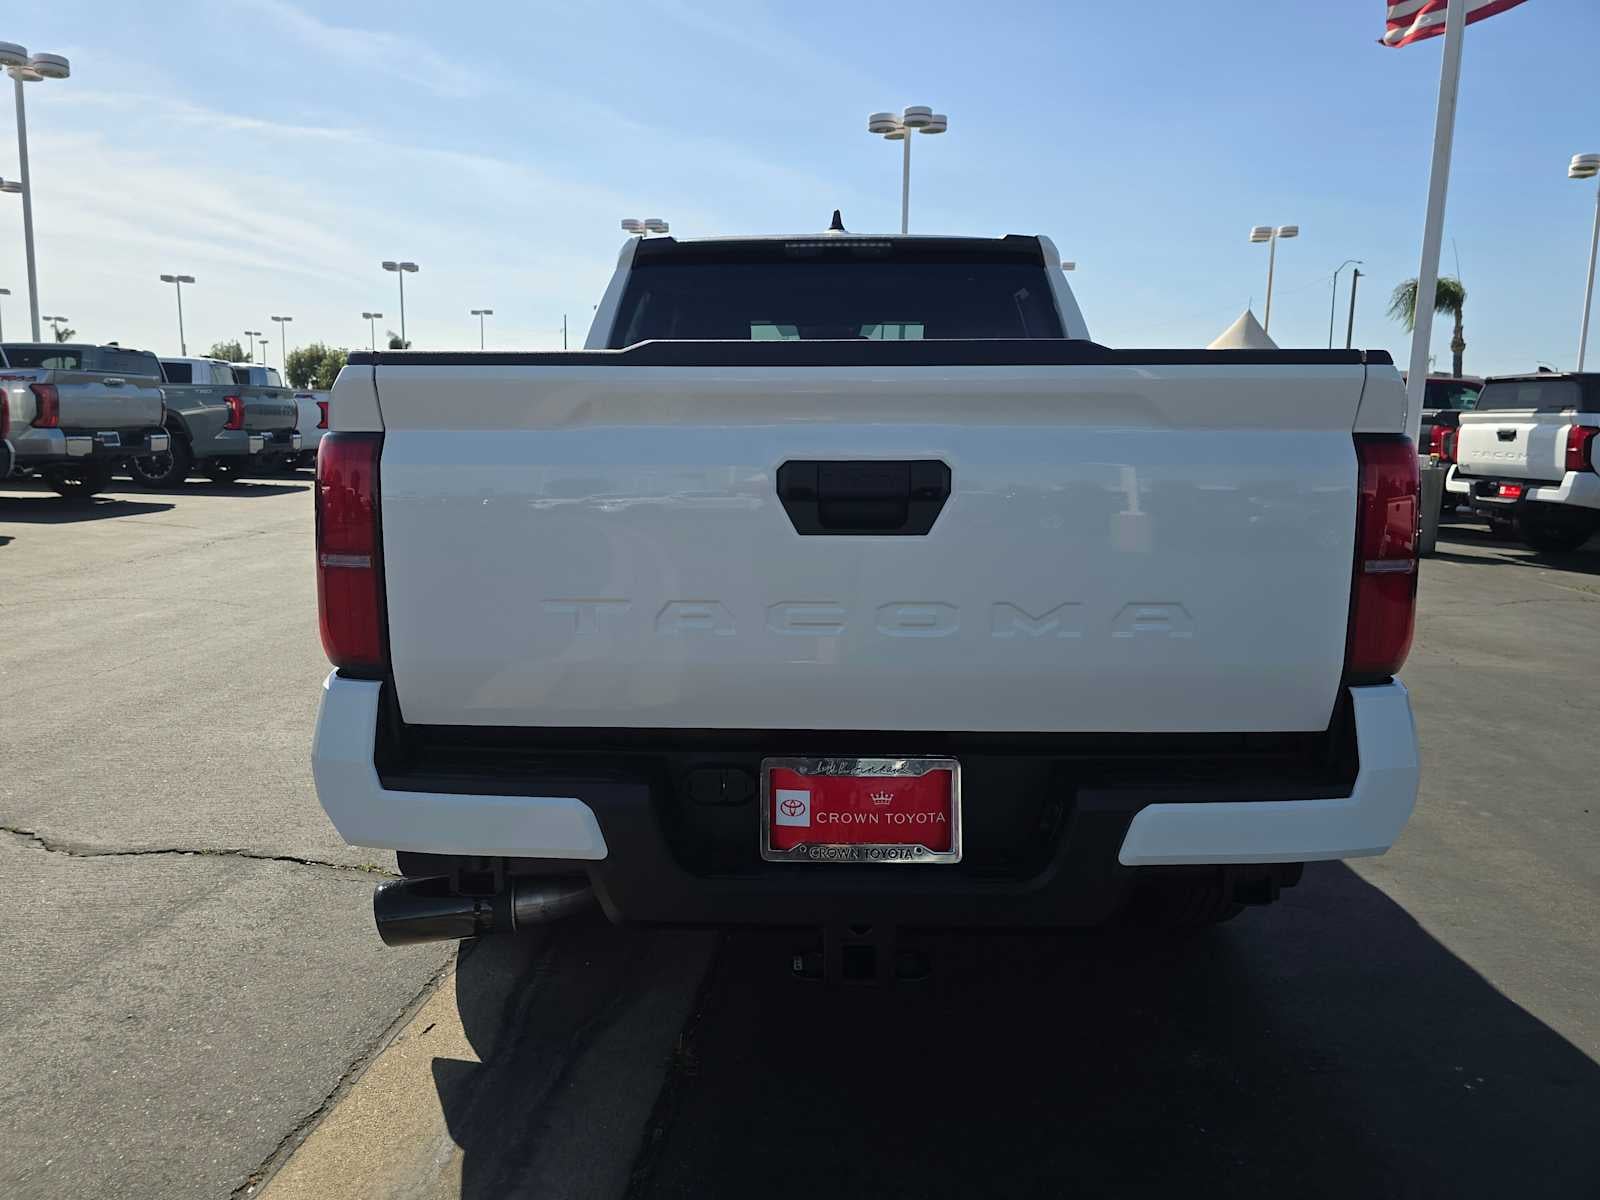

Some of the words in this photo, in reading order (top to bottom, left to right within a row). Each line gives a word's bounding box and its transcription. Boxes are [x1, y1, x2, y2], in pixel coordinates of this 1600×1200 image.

[541, 599, 1195, 640] TACOMA
[816, 812, 880, 824] CROWN
[884, 811, 946, 824] TOYOTA
[808, 847, 860, 859] CROWN
[863, 847, 913, 859] TOYOTA
